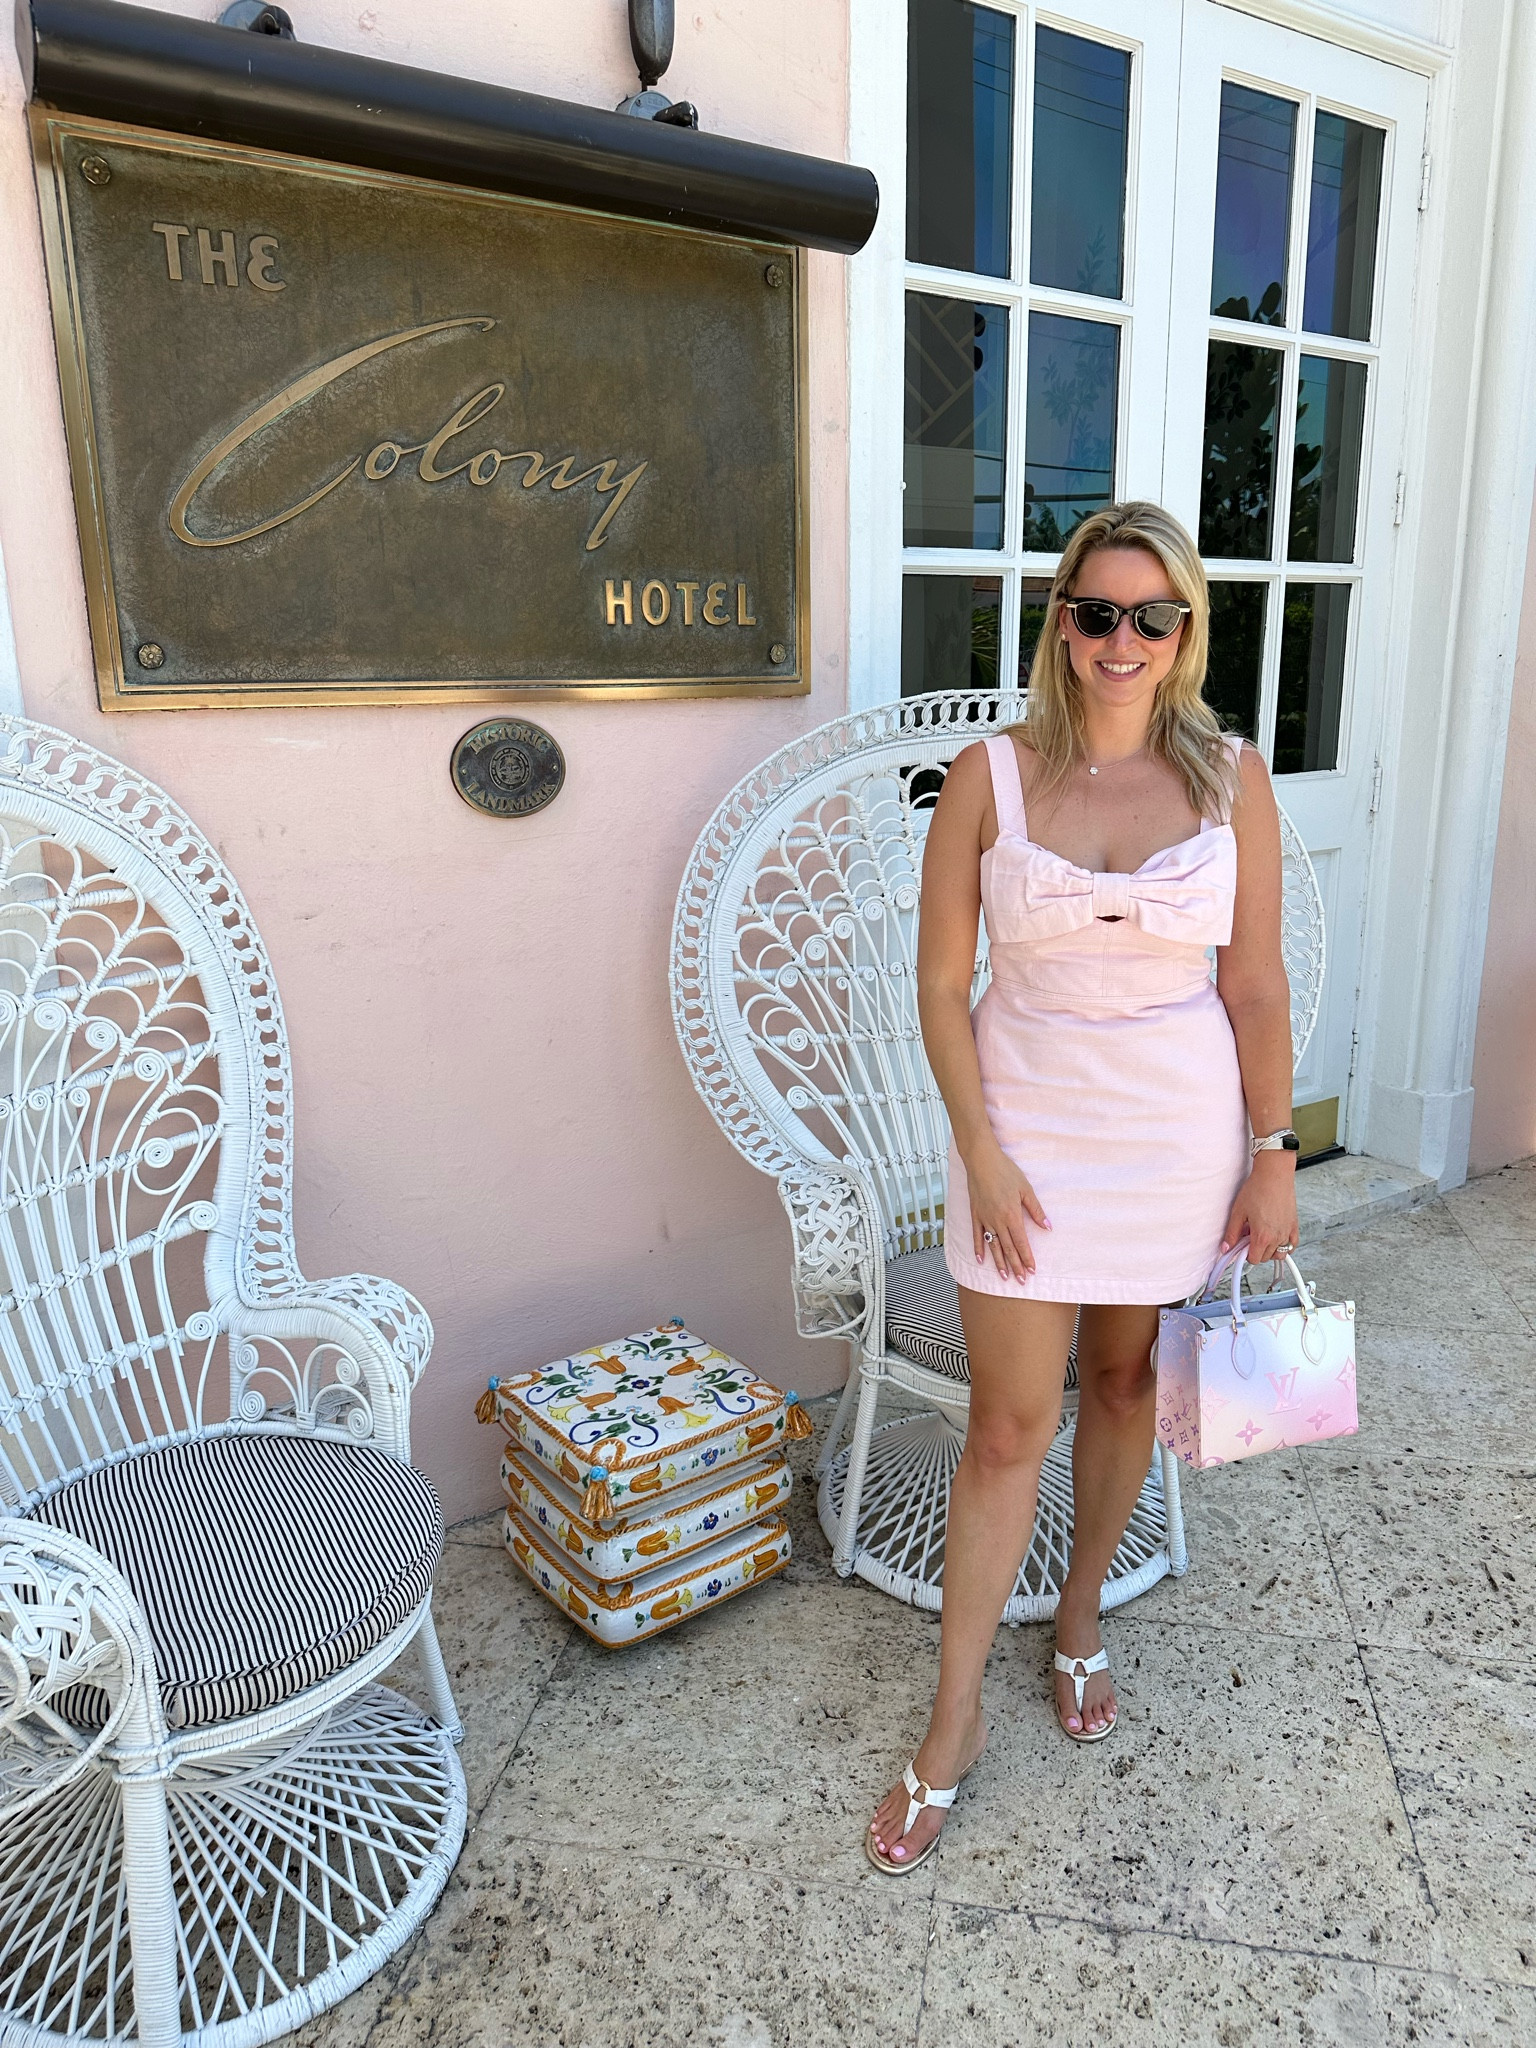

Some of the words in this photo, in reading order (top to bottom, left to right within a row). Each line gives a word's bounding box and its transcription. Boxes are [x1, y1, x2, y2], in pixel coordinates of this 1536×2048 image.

[153, 222, 287, 292] THE
[168, 316, 648, 550] Colony
[604, 580, 757, 627] HOTEL
[468, 725, 550, 755] HISTORIC
[465, 781, 555, 811] LANDMARK
